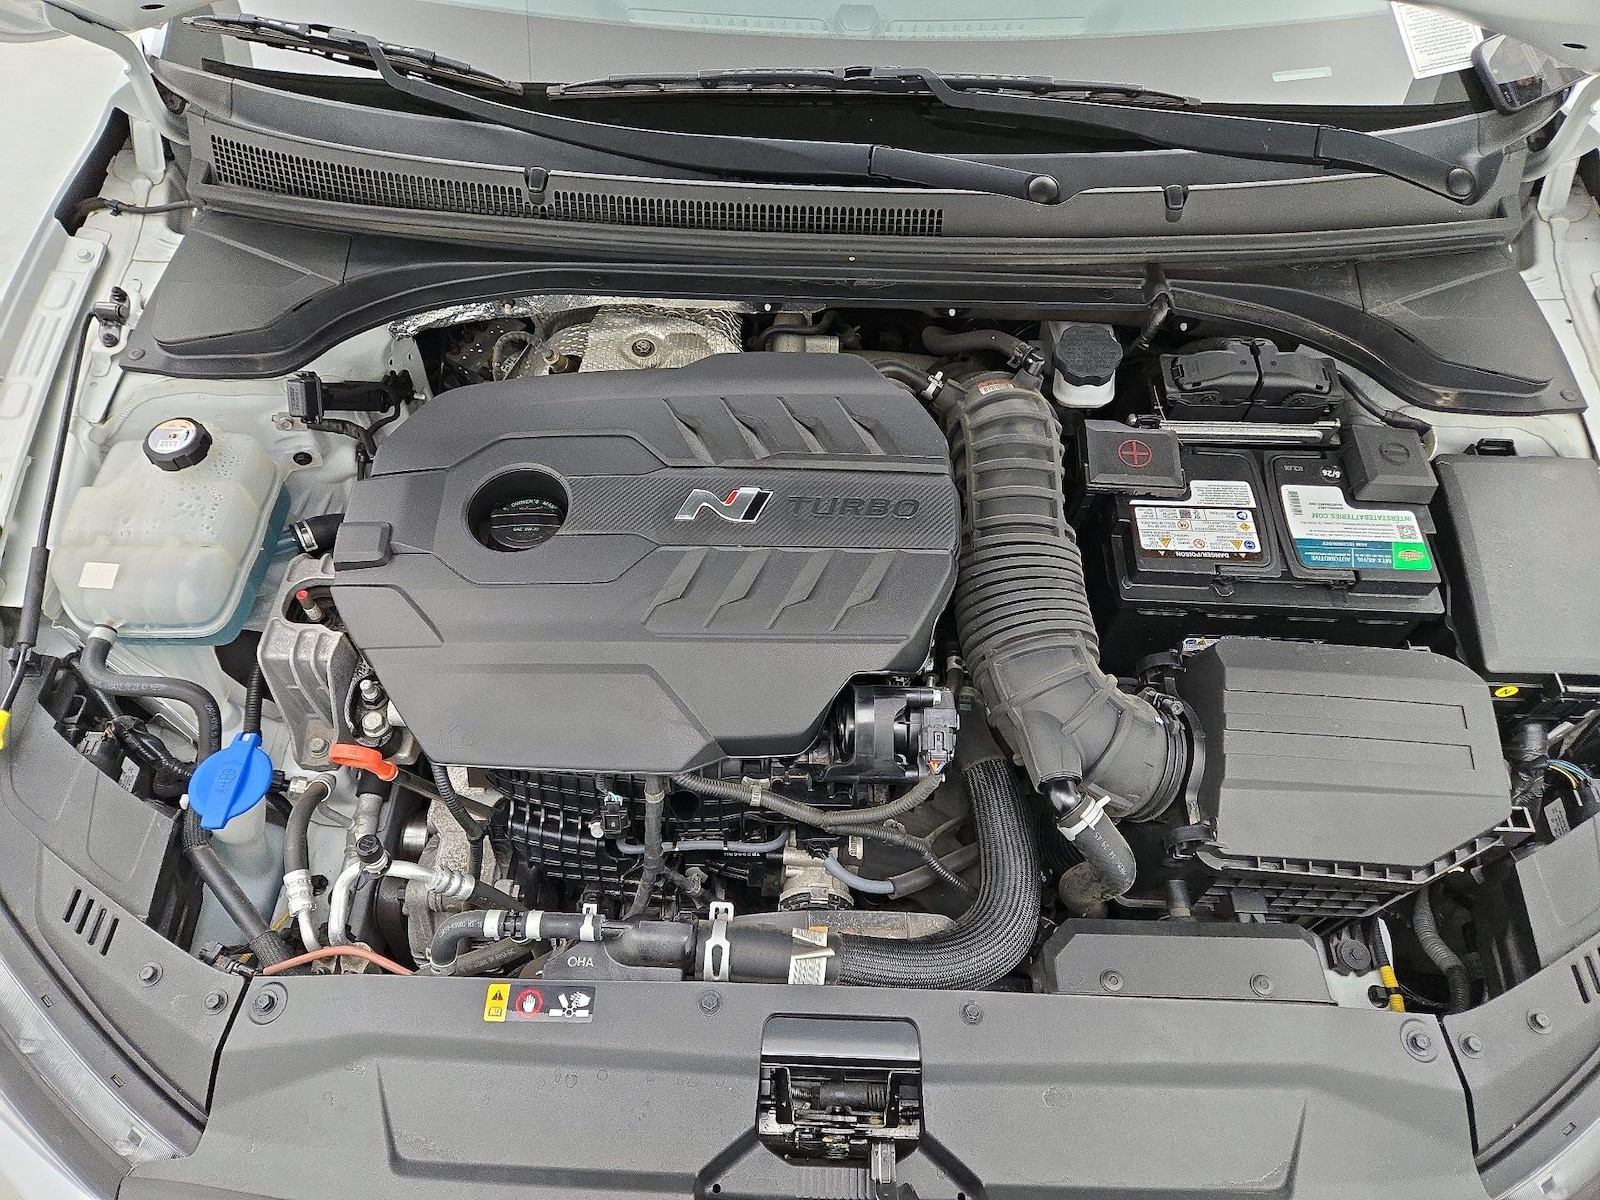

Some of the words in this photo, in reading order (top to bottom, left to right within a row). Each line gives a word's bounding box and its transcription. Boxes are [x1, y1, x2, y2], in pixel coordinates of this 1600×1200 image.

[1322, 469, 1341, 479] 6/26
[511, 499, 540, 508] OWNER'S
[788, 495, 921, 519] TURBO
[1312, 512, 1412, 521] INTERSTATEBATTERIES.COM
[1311, 555, 1351, 563] AUTOMOTIVE
[567, 956, 595, 968] OHA
